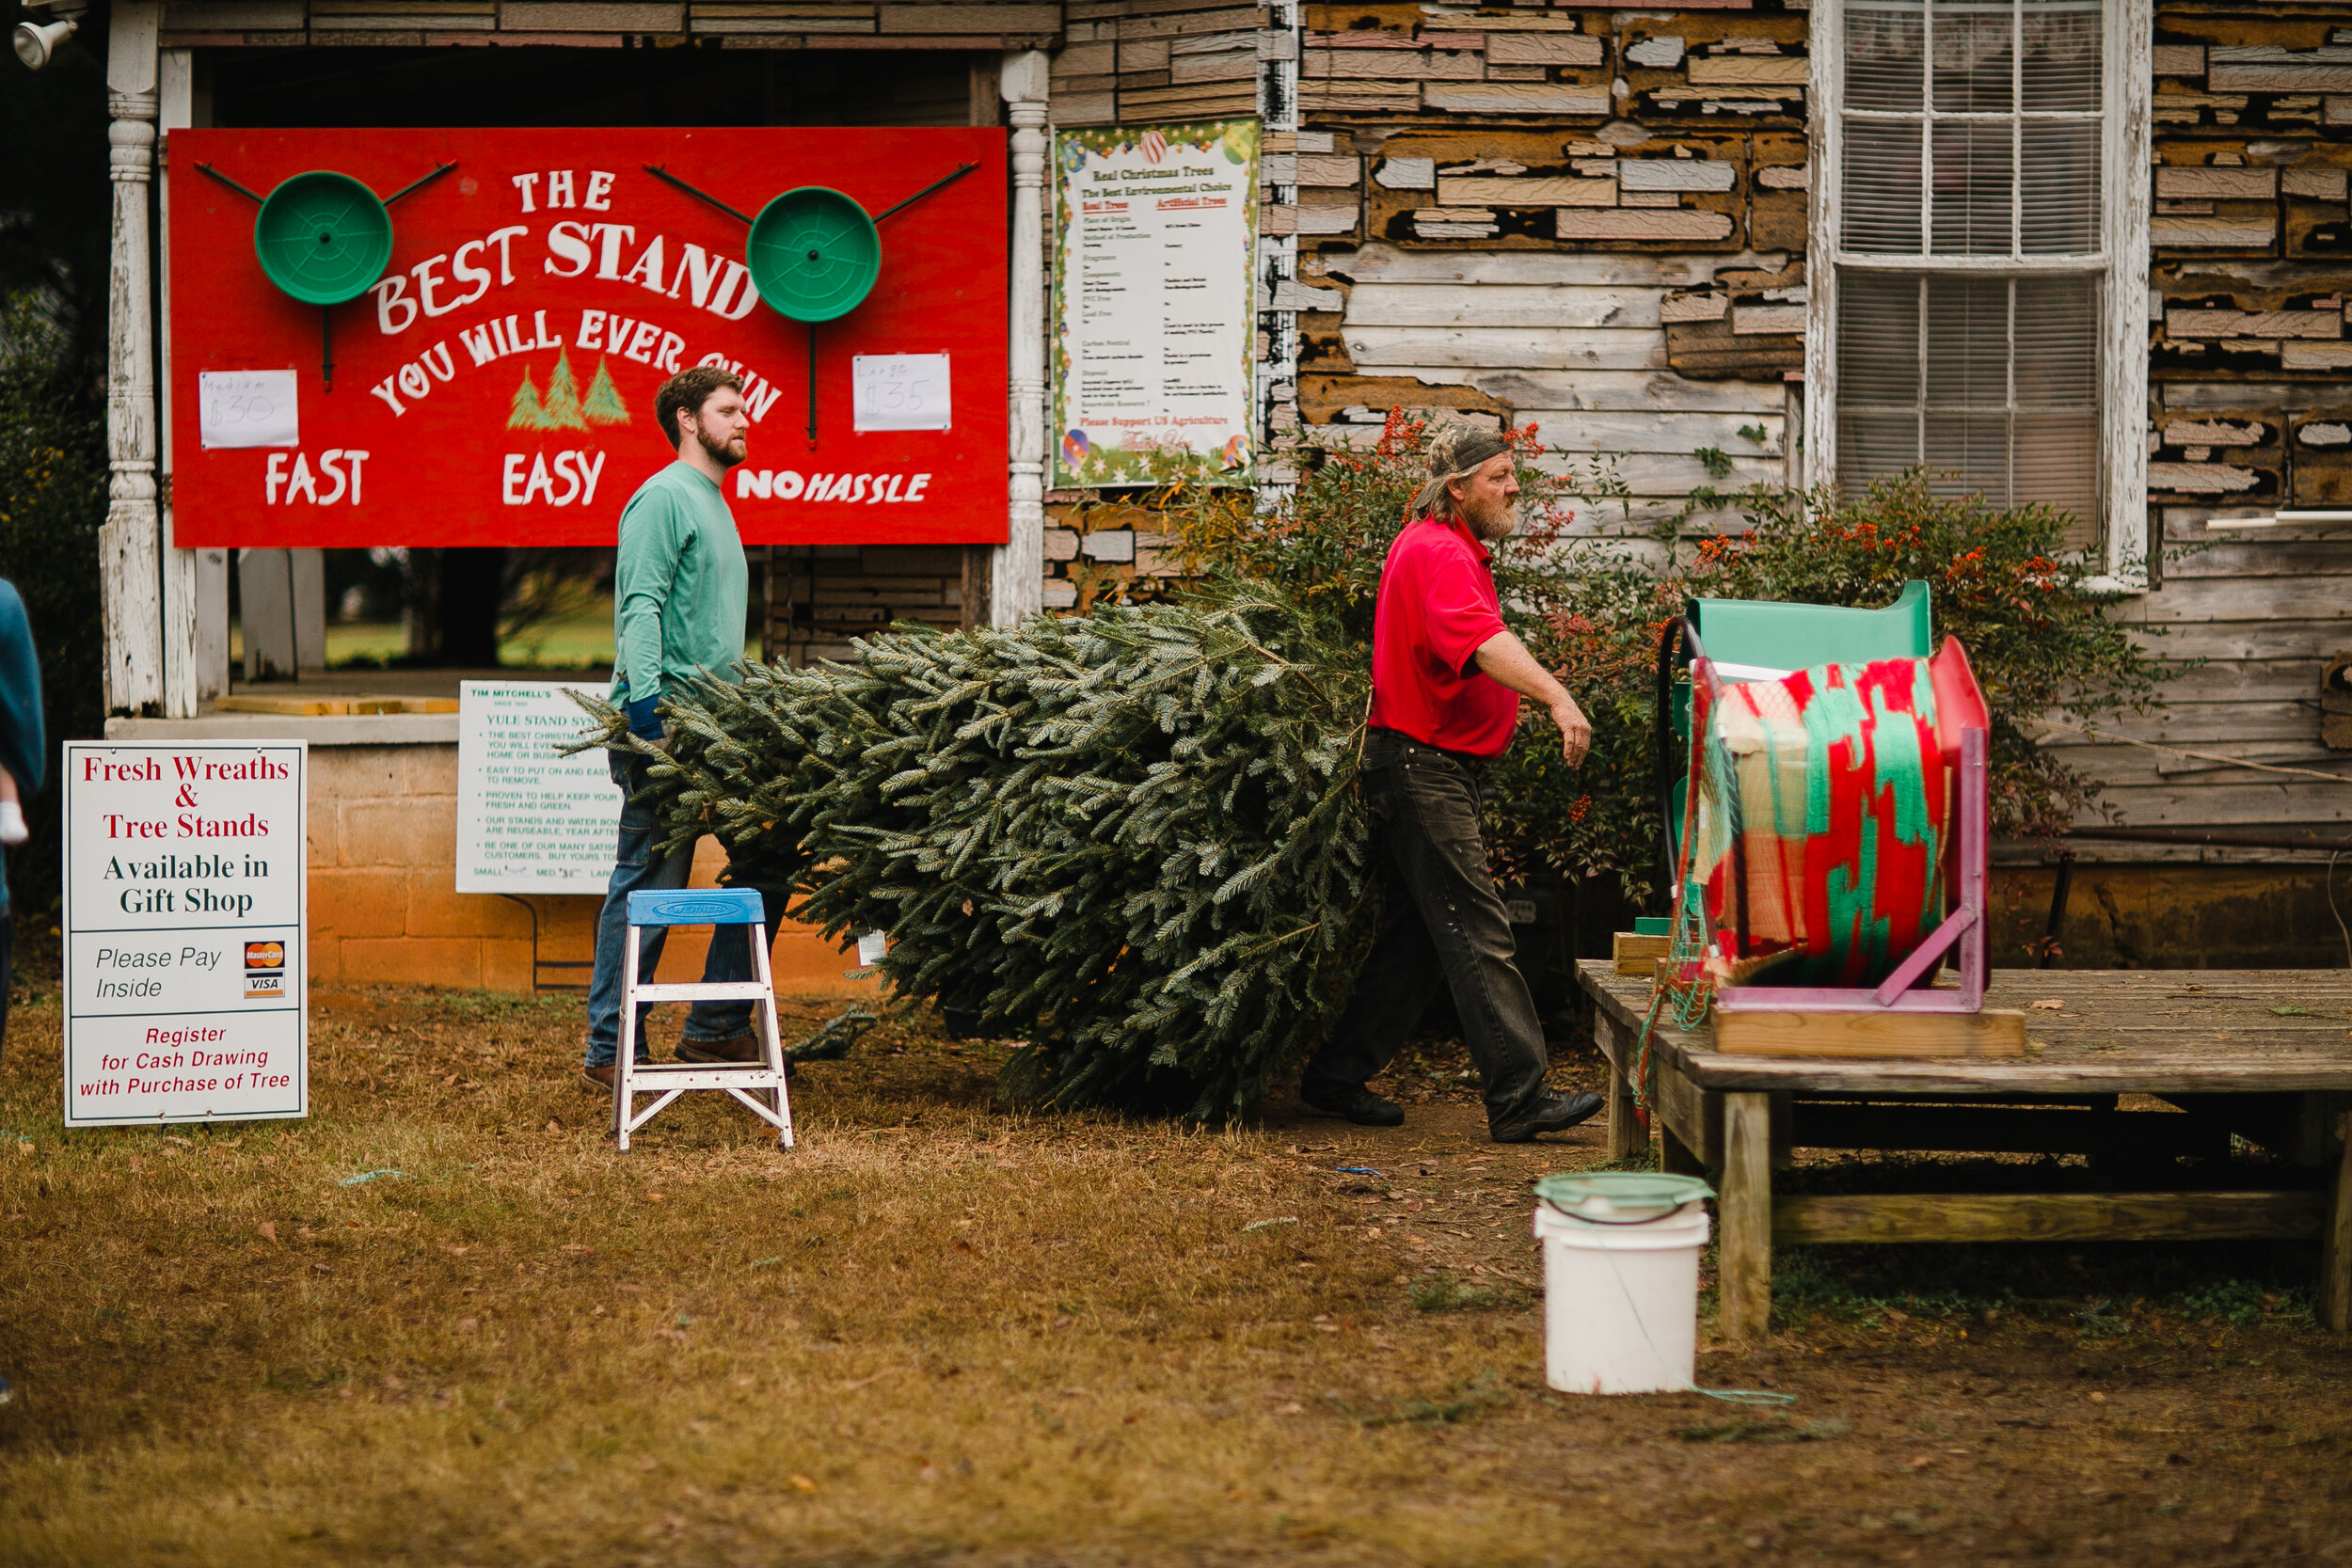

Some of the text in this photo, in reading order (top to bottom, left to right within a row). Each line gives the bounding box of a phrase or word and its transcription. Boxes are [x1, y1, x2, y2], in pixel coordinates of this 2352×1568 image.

[1093, 166, 1214, 182] Real Christmas Trees
[513, 170, 615, 213] THE
[1082, 182, 1232, 198] The Best Environmental Choice
[367, 221, 759, 336] BEST STAND
[371, 341, 455, 418] YOU
[459, 310, 562, 368] WILL
[576, 309, 686, 375] EVER
[1080, 418, 1108, 426] Please
[1112, 418, 1151, 427] Support
[1172, 417, 1228, 426] Agriculture
[265, 449, 370, 506] FAST
[502, 451, 606, 507] EASY
[471, 689, 551, 699] TIM MITCHELL'S
[487, 715, 520, 725] YULE
[525, 715, 568, 726] STAND
[510, 741, 530, 750] WILL
[533, 752, 578, 760] BUSINSS.
[83, 755, 290, 783] Fresh Wreaths
[175, 783, 199, 808] &
[594, 793, 617, 801] YOUR
[103, 813, 269, 839] Tree Stands
[103, 854, 269, 880] Available in
[119, 888, 253, 918] Gift Shop
[96, 946, 222, 971] Please Pay
[246, 950, 284, 961] MasterCard
[96, 978, 162, 999] Inside
[251, 978, 279, 990] VISA
[145, 1027, 227, 1048] Register
[102, 1050, 269, 1071] for Cash Drawing
[80, 1072, 290, 1097] with Purchase of Tree
